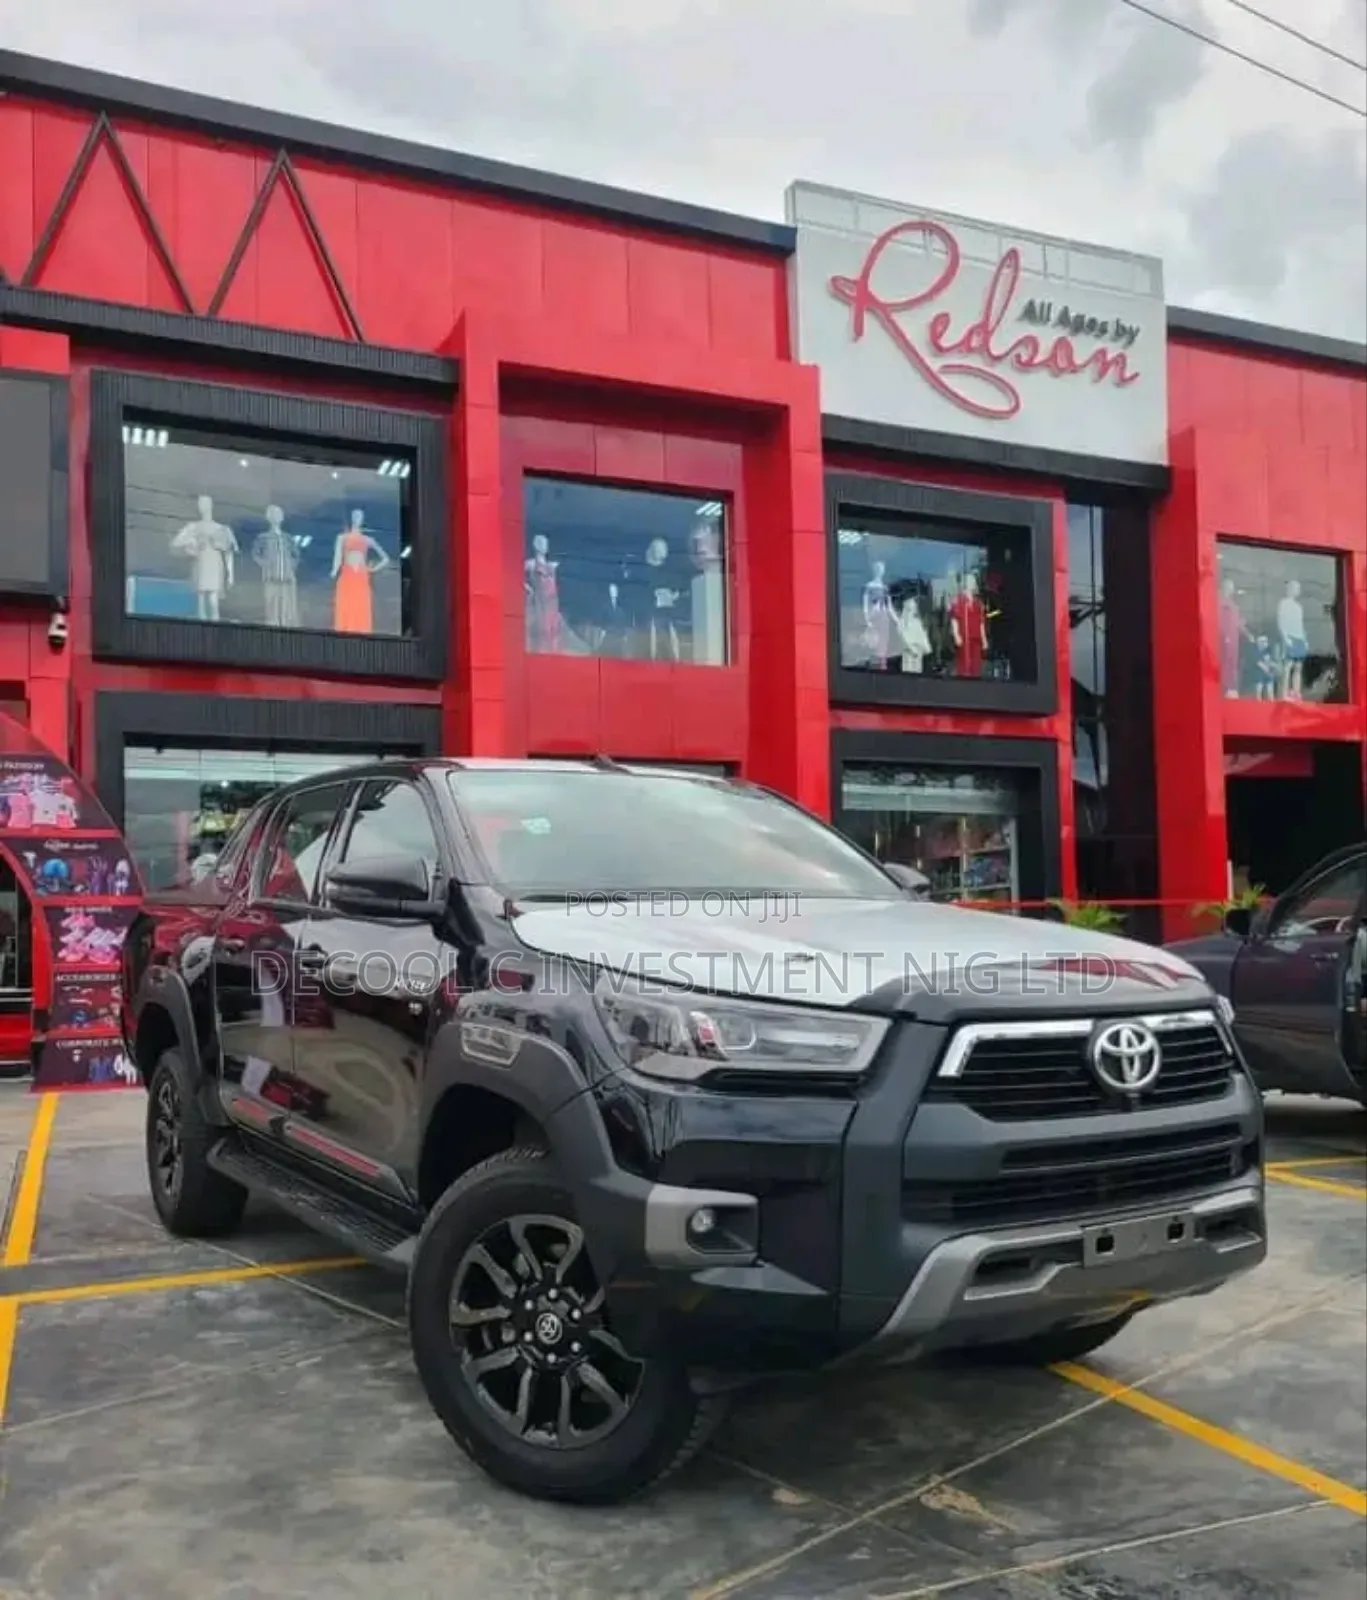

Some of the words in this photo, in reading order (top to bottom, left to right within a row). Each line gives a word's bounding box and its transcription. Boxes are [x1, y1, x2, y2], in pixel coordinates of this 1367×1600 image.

[828, 220, 1140, 420] Redson
[1018, 298, 1051, 325] All
[1054, 305, 1109, 337] Ages
[1113, 317, 1140, 348] by
